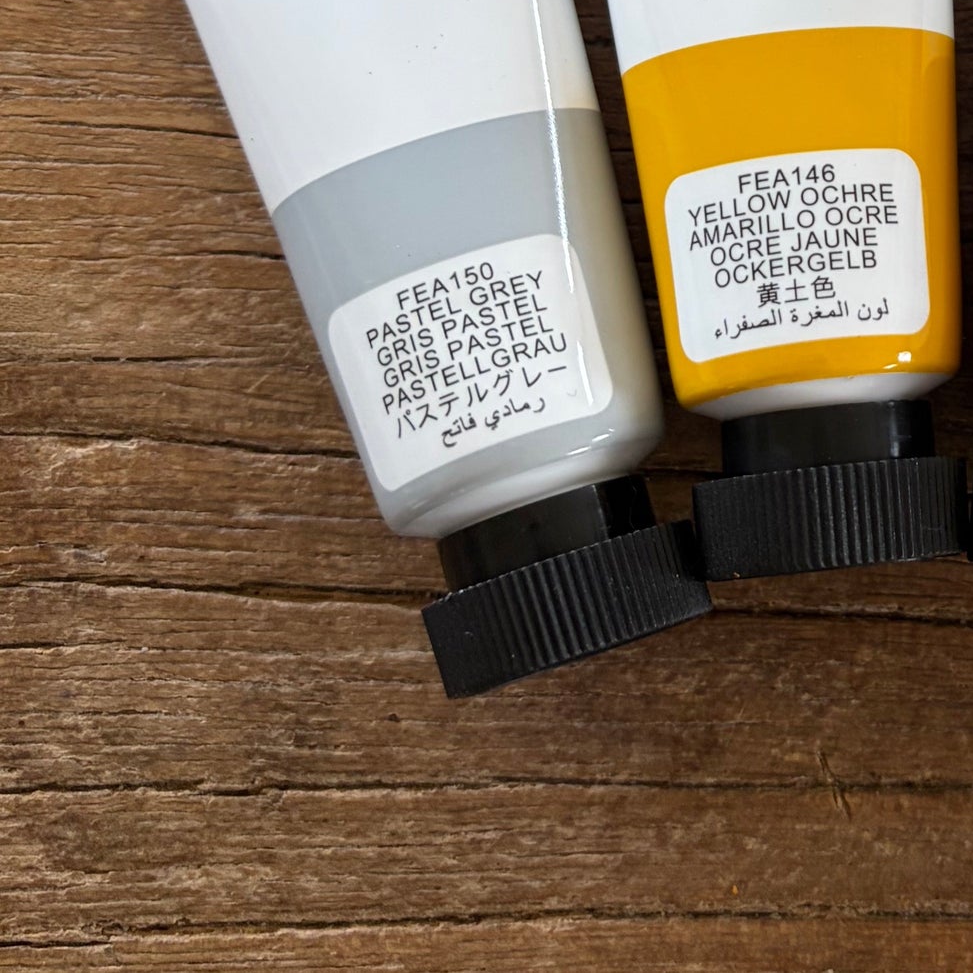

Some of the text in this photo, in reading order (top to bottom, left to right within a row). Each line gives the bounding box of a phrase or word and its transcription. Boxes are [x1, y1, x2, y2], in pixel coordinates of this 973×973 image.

[738, 164, 835, 194] FEA146
[688, 183, 895, 227] YELLOW OCHRE
[689, 205, 899, 251] AMARILLO OCRE
[710, 227, 878, 267] OCRE JAUNE
[715, 249, 877, 289] OCKERGELB
[366, 270, 543, 349] PASTEL GREY
[396, 262, 494, 310] FEA150
[757, 276, 836, 308] 黄土色
[377, 294, 548, 367] GRIS PASTEL
[714, 297, 889, 340] لون المغرة الصفراء
[382, 332, 567, 415] PASTELLGRAU
[384, 315, 553, 388] GRIS PASTEL
[396, 365, 567, 439] パステルグレー
[441, 397, 546, 448] رمادي فاتح
